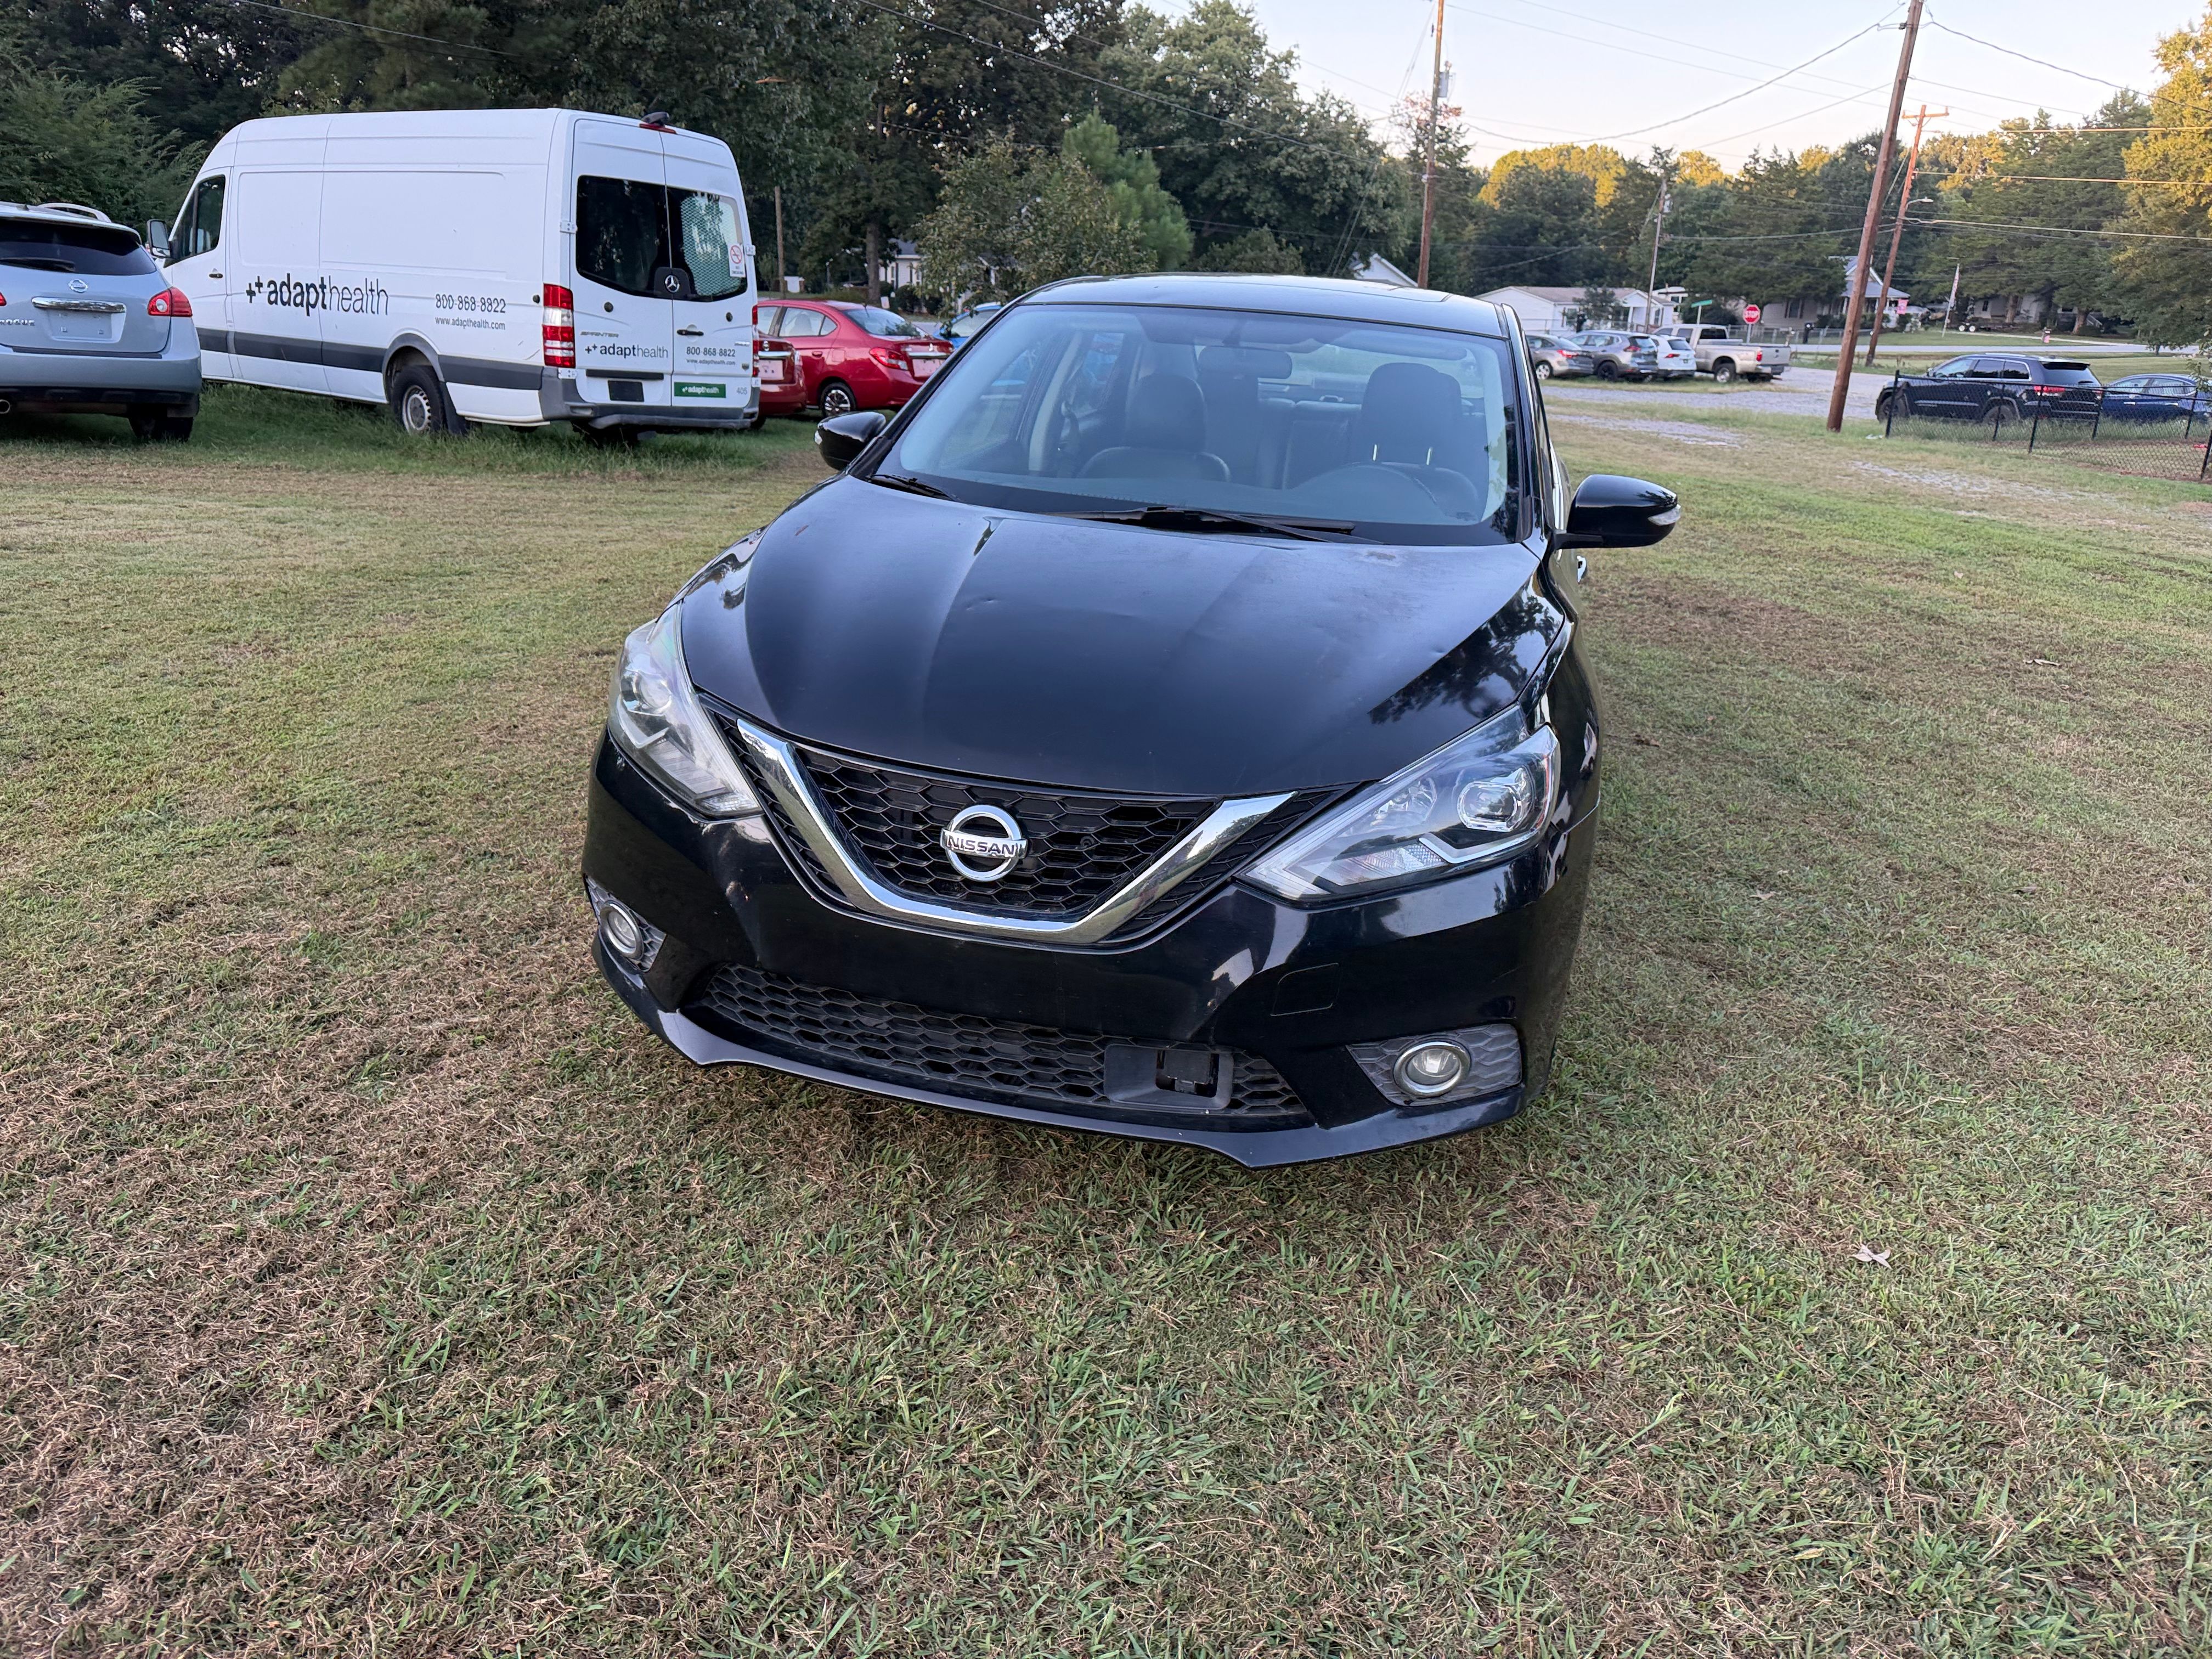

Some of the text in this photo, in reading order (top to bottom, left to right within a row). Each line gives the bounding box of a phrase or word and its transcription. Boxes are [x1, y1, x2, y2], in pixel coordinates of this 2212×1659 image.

[267, 273, 388, 317] adapthealth
[436, 294, 506, 313] 800-868-8822
[435, 317, 505, 330] www.adapthealth.com
[600, 343, 669, 358] adapthealth
[947, 835, 1015, 855] NISSAN
